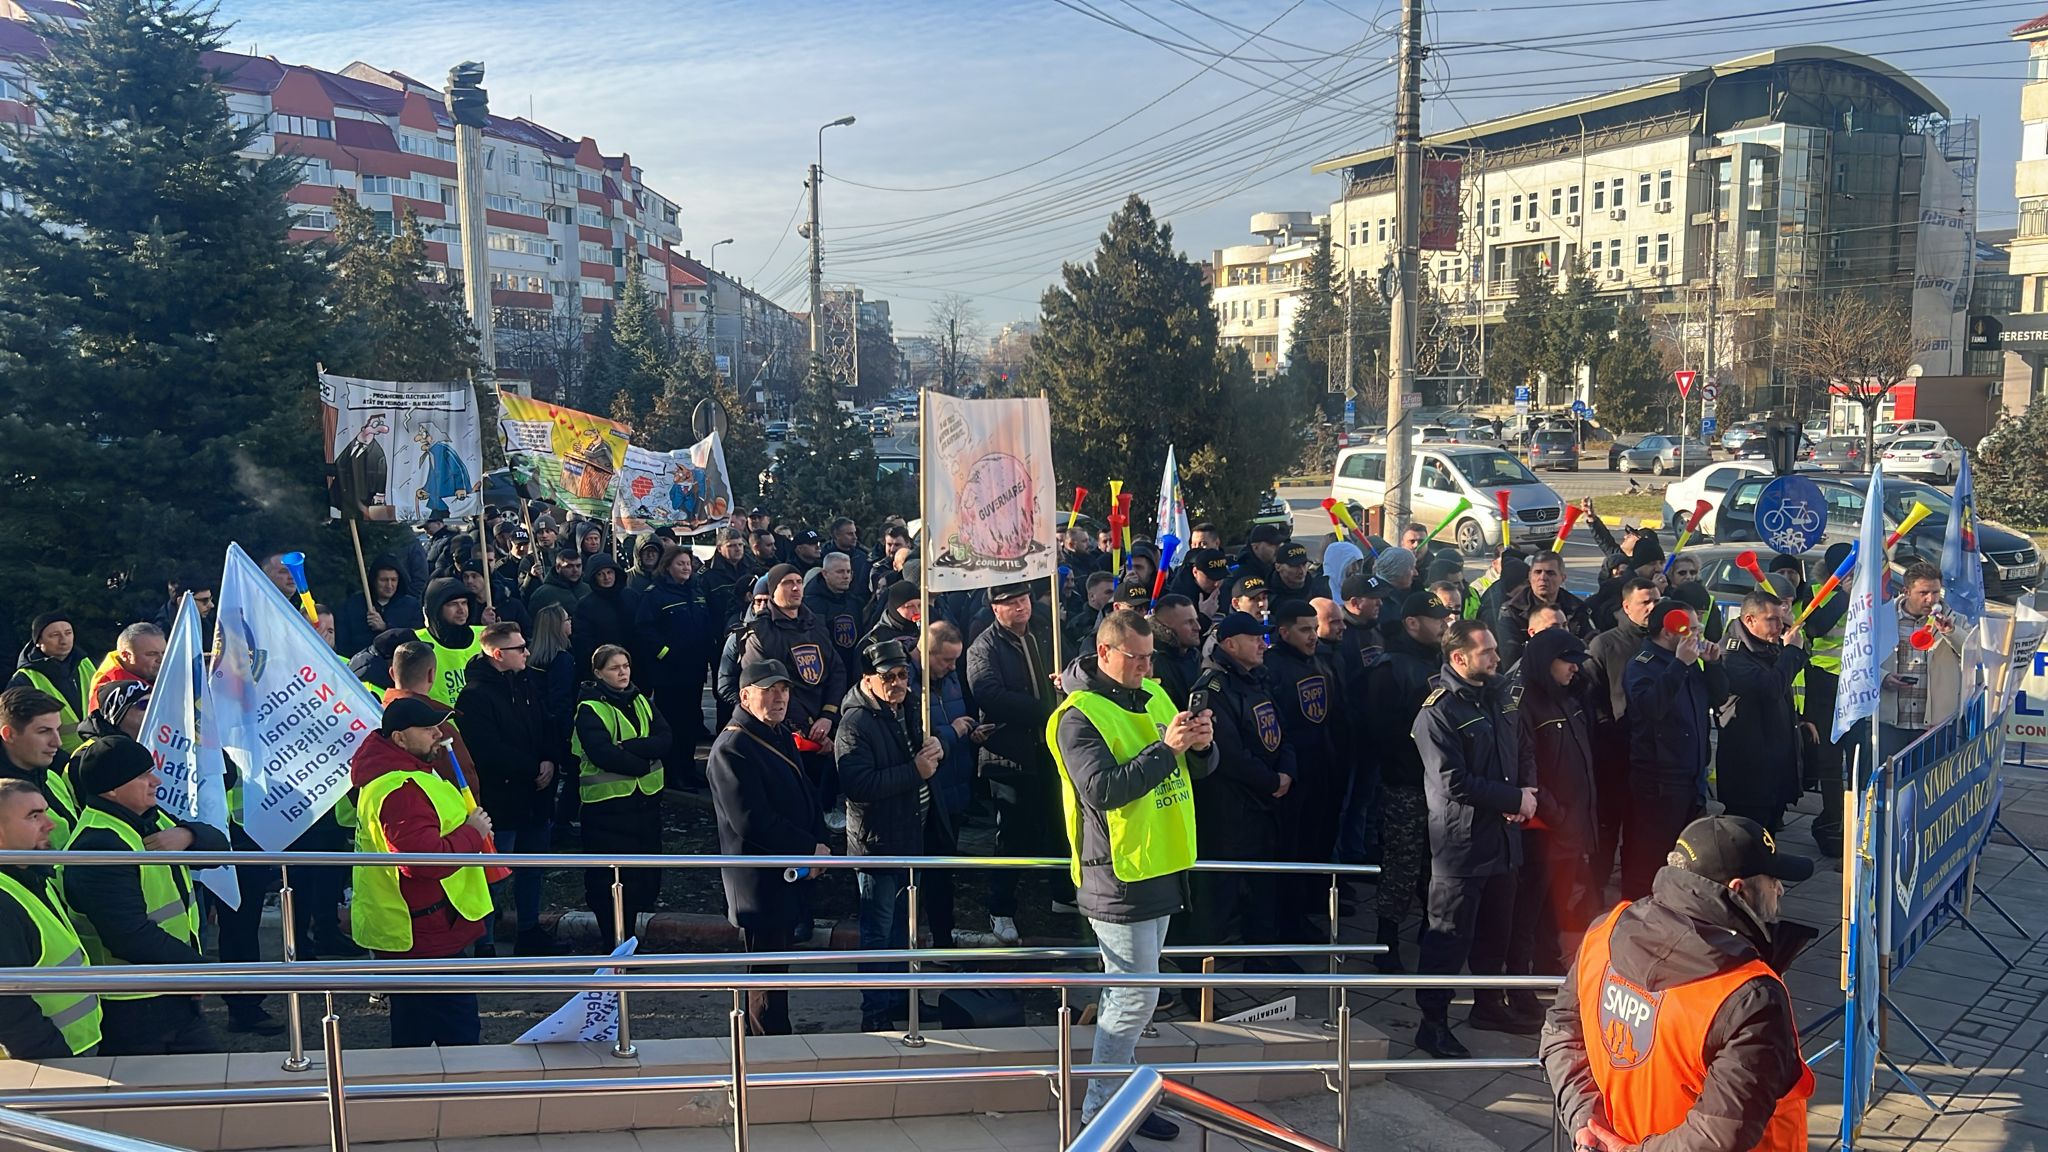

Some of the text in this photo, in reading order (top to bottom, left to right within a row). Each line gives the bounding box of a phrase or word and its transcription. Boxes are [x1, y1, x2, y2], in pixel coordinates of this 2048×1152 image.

[797, 654, 816, 667] SNPP
[444, 669, 465, 688] SN
[1302, 687, 1322, 703] SNPP
[1603, 985, 1650, 1028] SNPP
